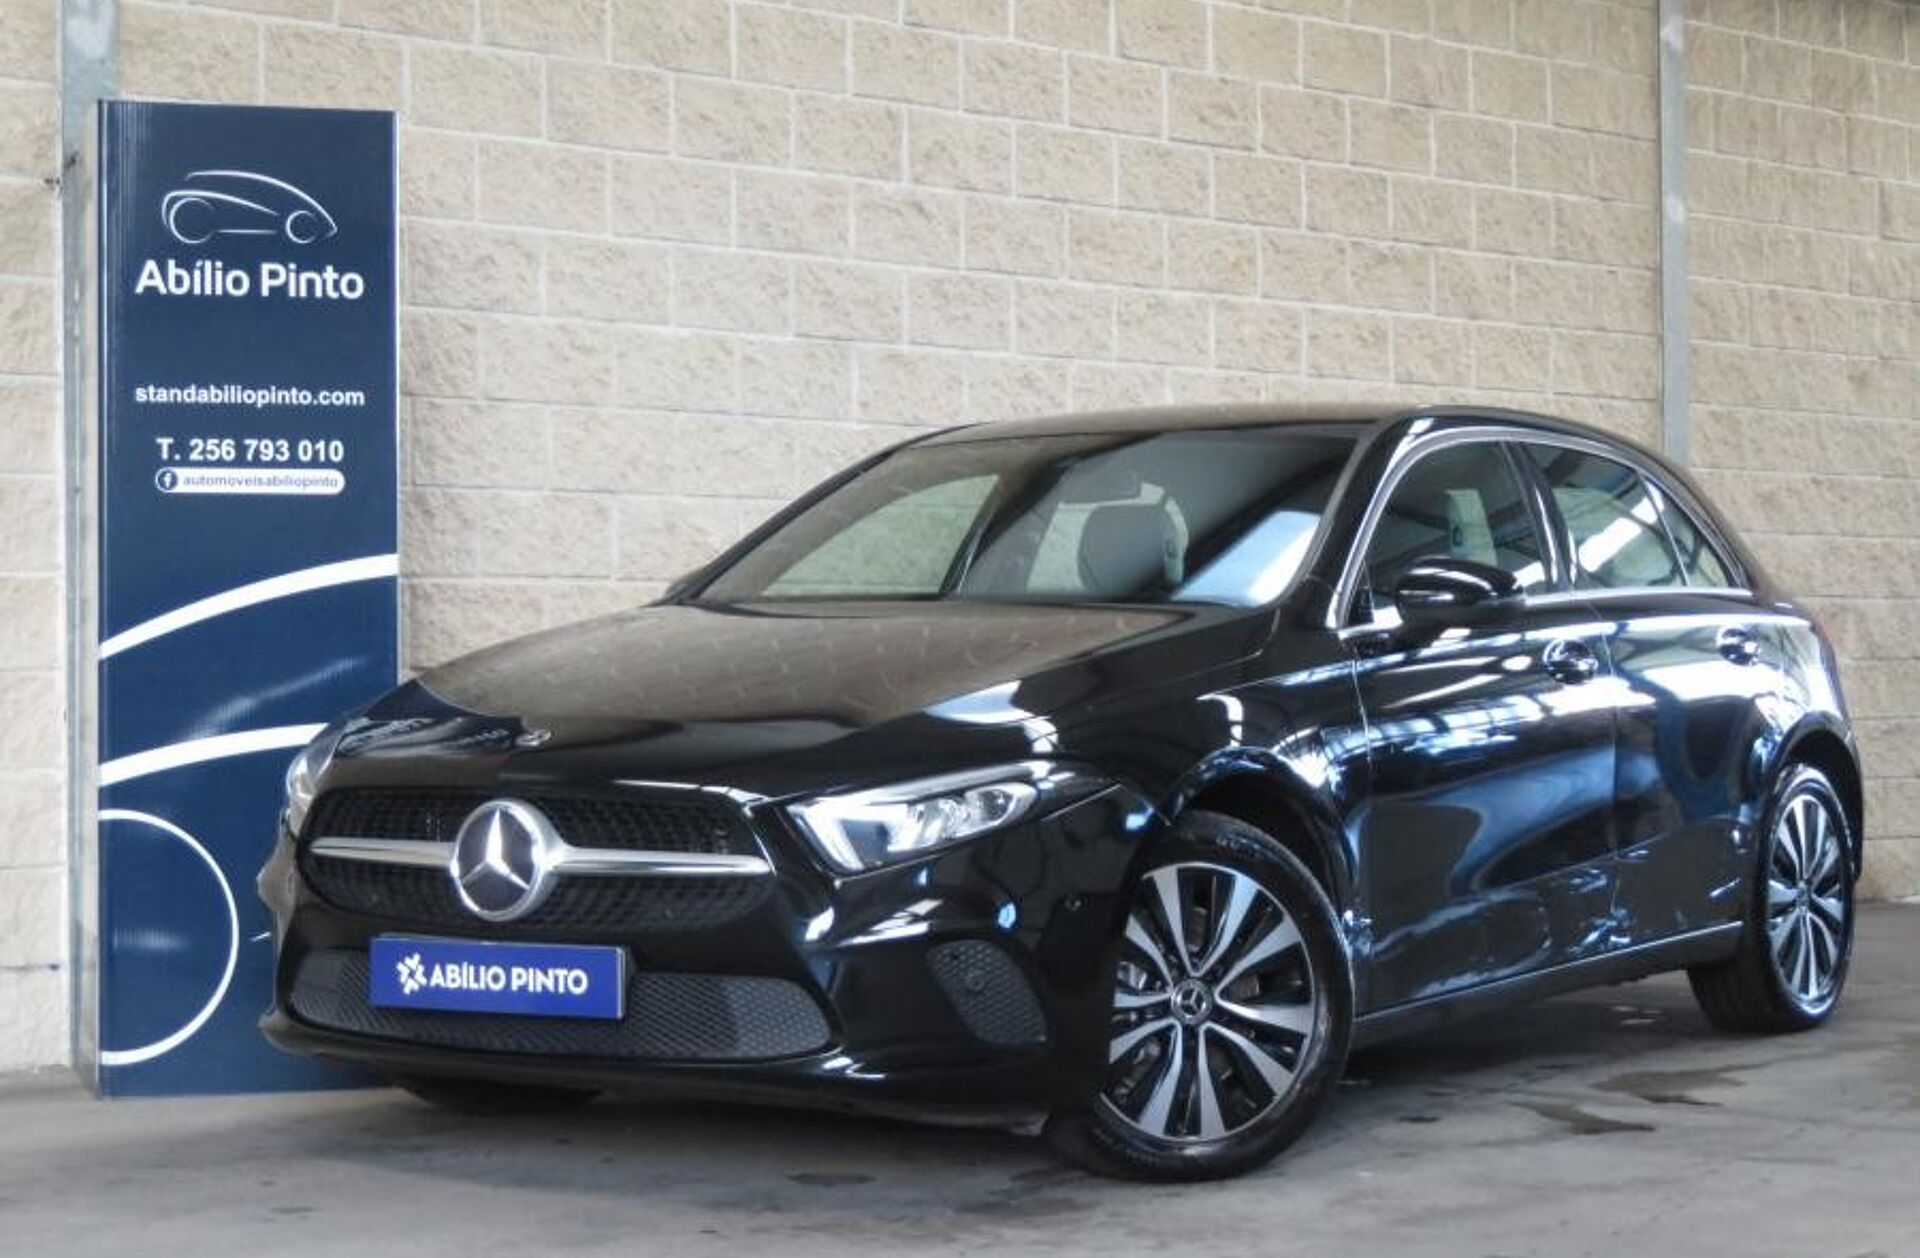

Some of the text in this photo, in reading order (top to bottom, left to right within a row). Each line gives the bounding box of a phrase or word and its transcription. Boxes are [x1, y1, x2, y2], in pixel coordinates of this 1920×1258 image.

[135, 259, 365, 299] Abílio Pinto
[135, 384, 366, 408] standabiliopinto.com
[156, 437, 344, 462] T. 256 793 010
[183, 475, 338, 490] automoveisabiliopinto
[429, 961, 588, 995] ABÍLIO PINTO
